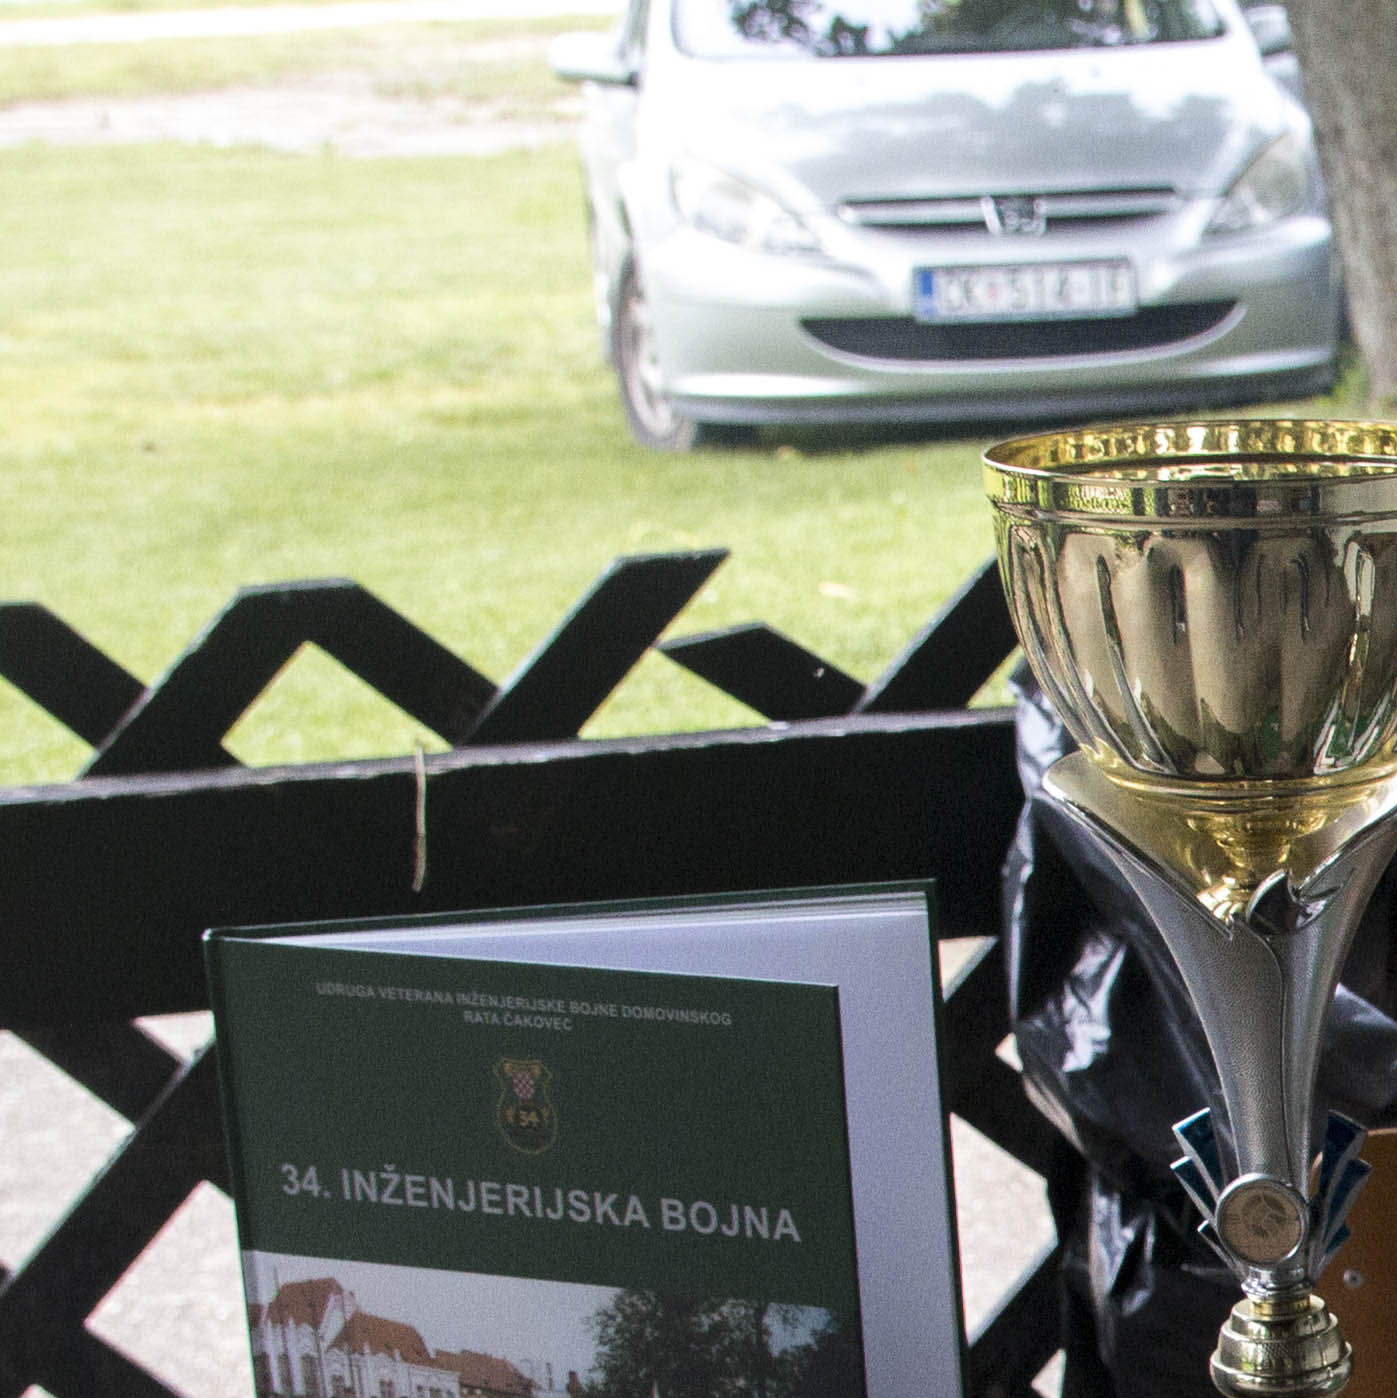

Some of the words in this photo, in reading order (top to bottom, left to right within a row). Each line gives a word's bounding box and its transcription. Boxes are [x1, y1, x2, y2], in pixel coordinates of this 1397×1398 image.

[315, 983, 376, 998] UDRUGA
[378, 986, 454, 1004] VETERANA
[456, 991, 564, 1013] INŽENJERIJSKE
[568, 1001, 618, 1018] BOJNE
[622, 1004, 732, 1026] DOMOVINSKOG
[463, 1009, 500, 1025] RATA
[502, 1011, 572, 1031] ČAKOVEC
[280, 1162, 331, 1198] 34.
[341, 1163, 651, 1229] INŽENJERIJSKA
[659, 1197, 801, 1242] BOJNA
